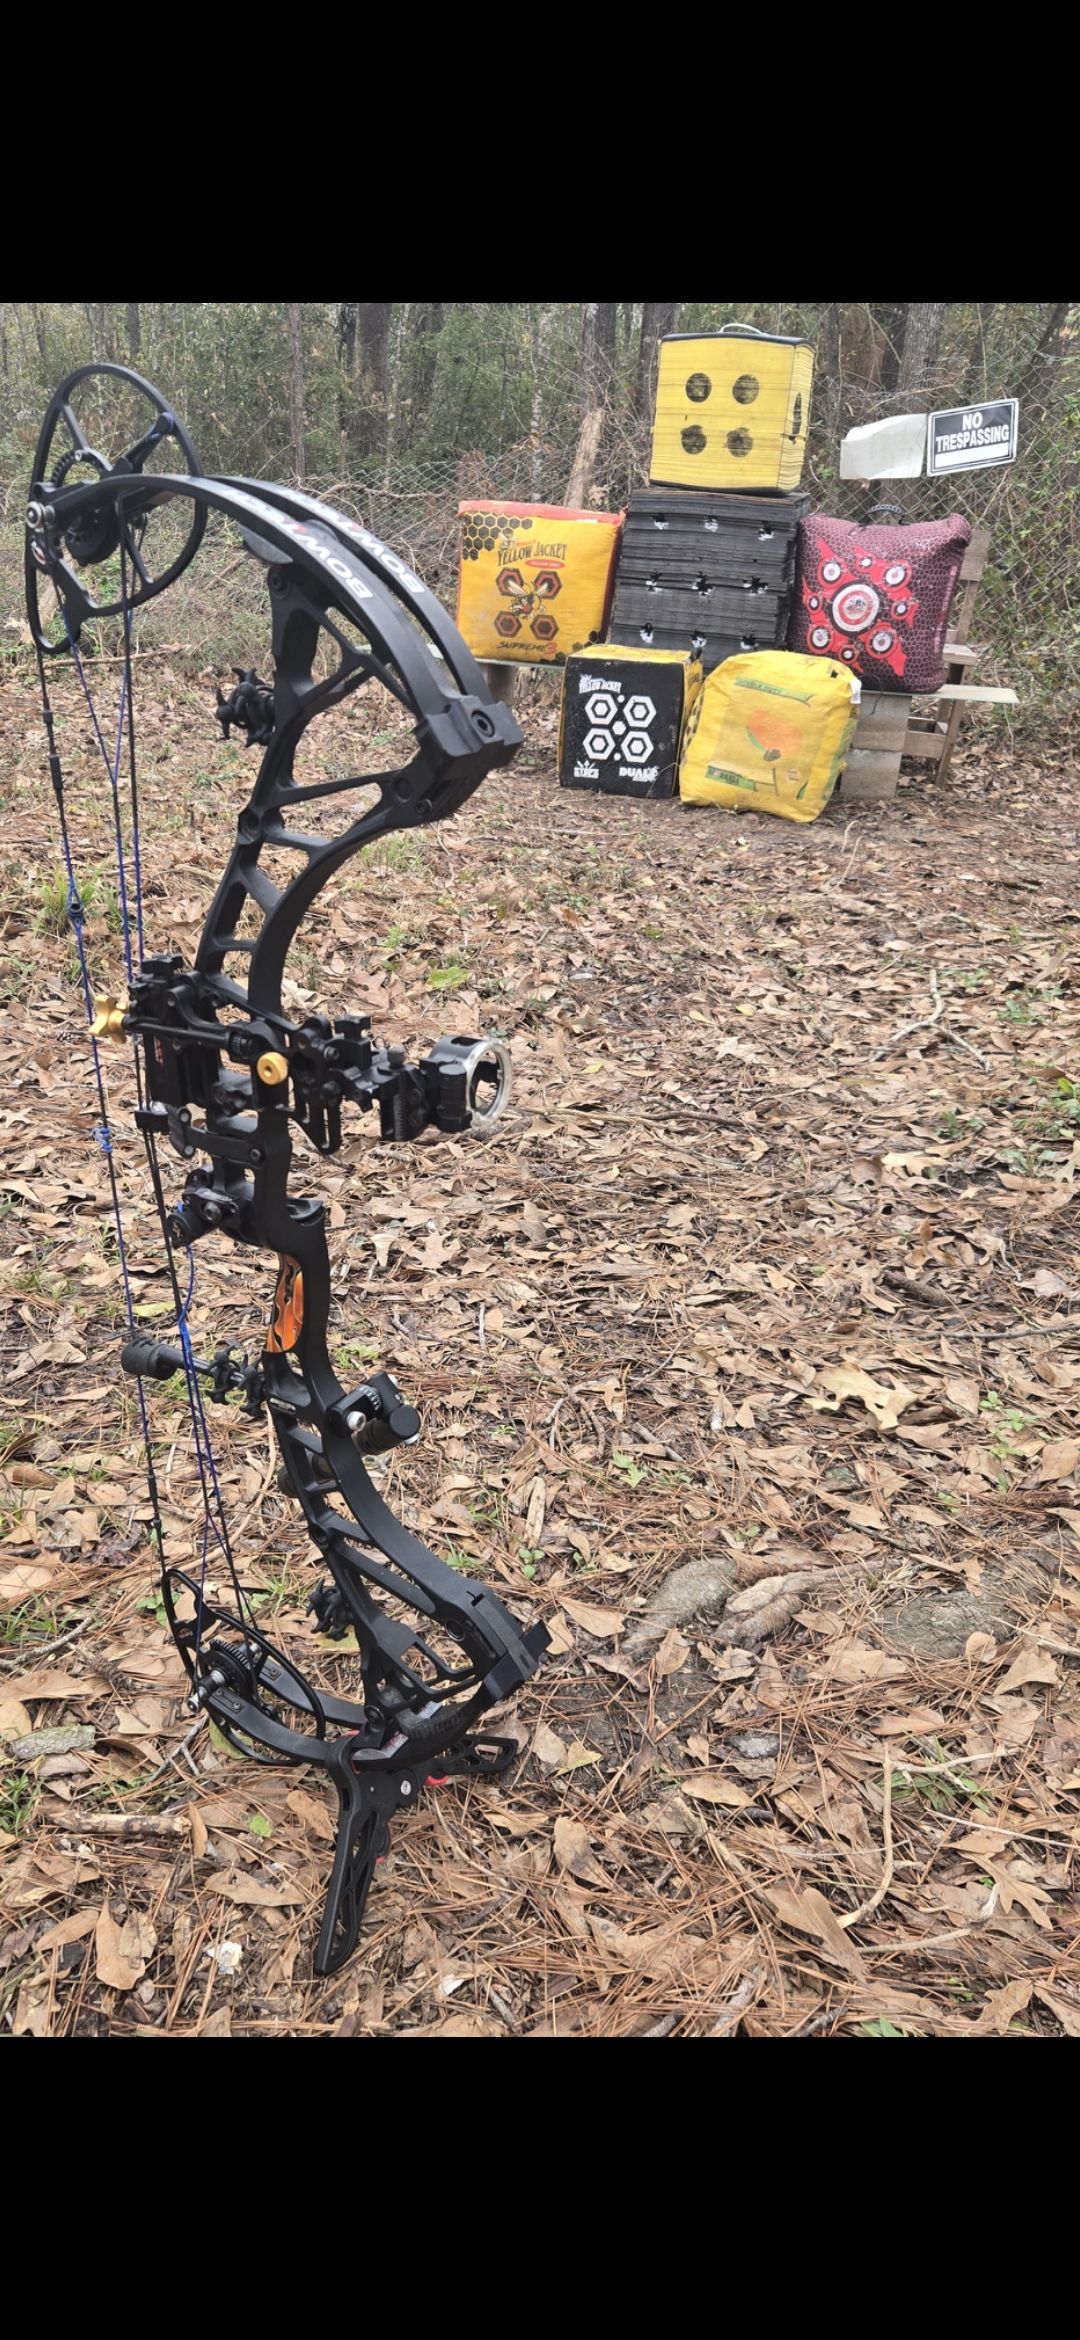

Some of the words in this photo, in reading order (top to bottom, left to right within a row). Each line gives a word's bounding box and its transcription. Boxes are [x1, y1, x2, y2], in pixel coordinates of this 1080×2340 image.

[962, 412, 983, 430] NO
[936, 424, 1009, 452] TRESPASSING
[498, 546, 532, 566] YELLOW
[533, 543, 567, 560] JACKET
[497, 641, 546, 652] SUPREME
